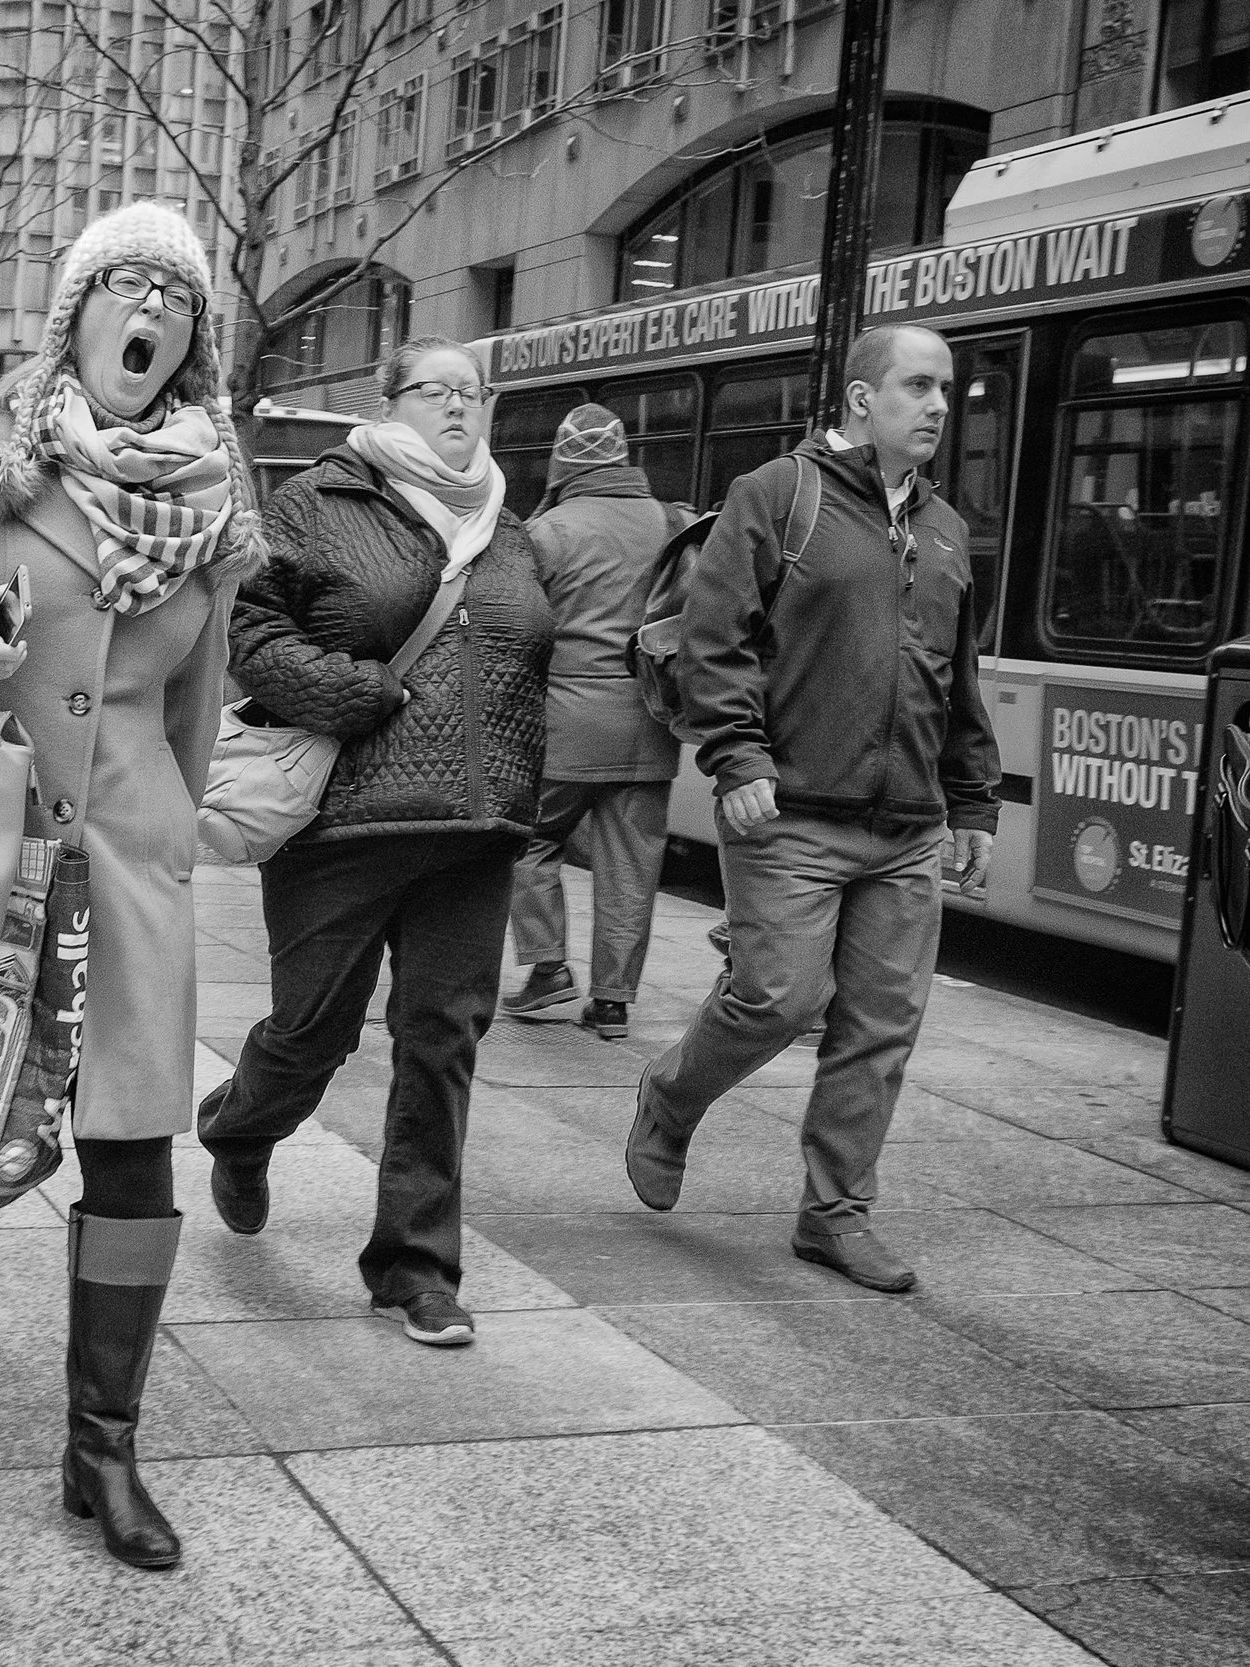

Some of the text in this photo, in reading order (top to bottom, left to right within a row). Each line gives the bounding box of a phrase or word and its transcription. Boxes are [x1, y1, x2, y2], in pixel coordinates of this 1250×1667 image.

[501, 327, 577, 373] BOSTON'S
[579, 314, 646, 361] EXPERT
[683, 295, 740, 346] CARE
[863, 260, 913, 316] THE
[914, 236, 1040, 308] BOSTON
[1046, 216, 1139, 287] WAIT
[1052, 707, 1188, 765] BOSTON'S
[1052, 752, 1177, 811] WITHOUT
